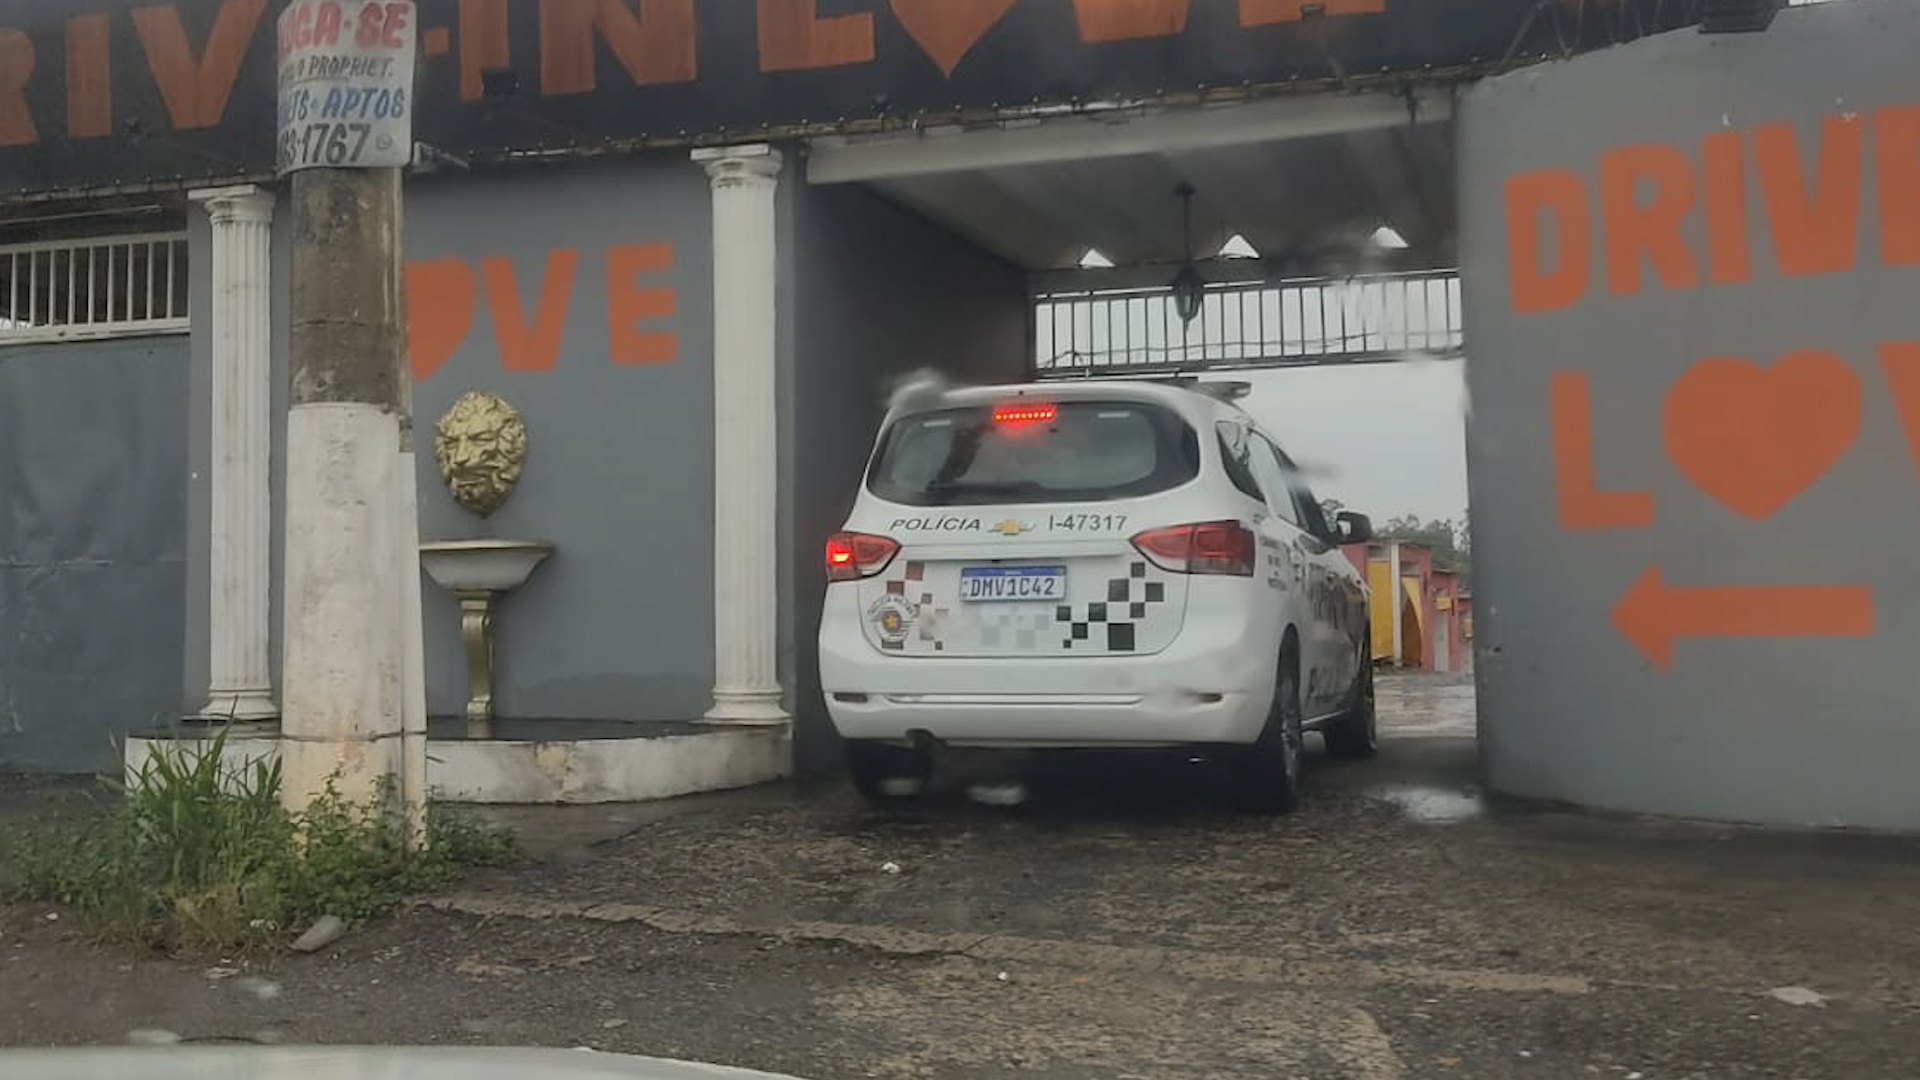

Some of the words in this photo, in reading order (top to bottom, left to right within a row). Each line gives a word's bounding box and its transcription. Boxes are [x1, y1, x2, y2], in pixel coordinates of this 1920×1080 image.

[889, 514, 981, 531] POLÍCIA
[1049, 514, 1128, 531] I-47317
[970, 577, 1055, 598] DMV1C42
